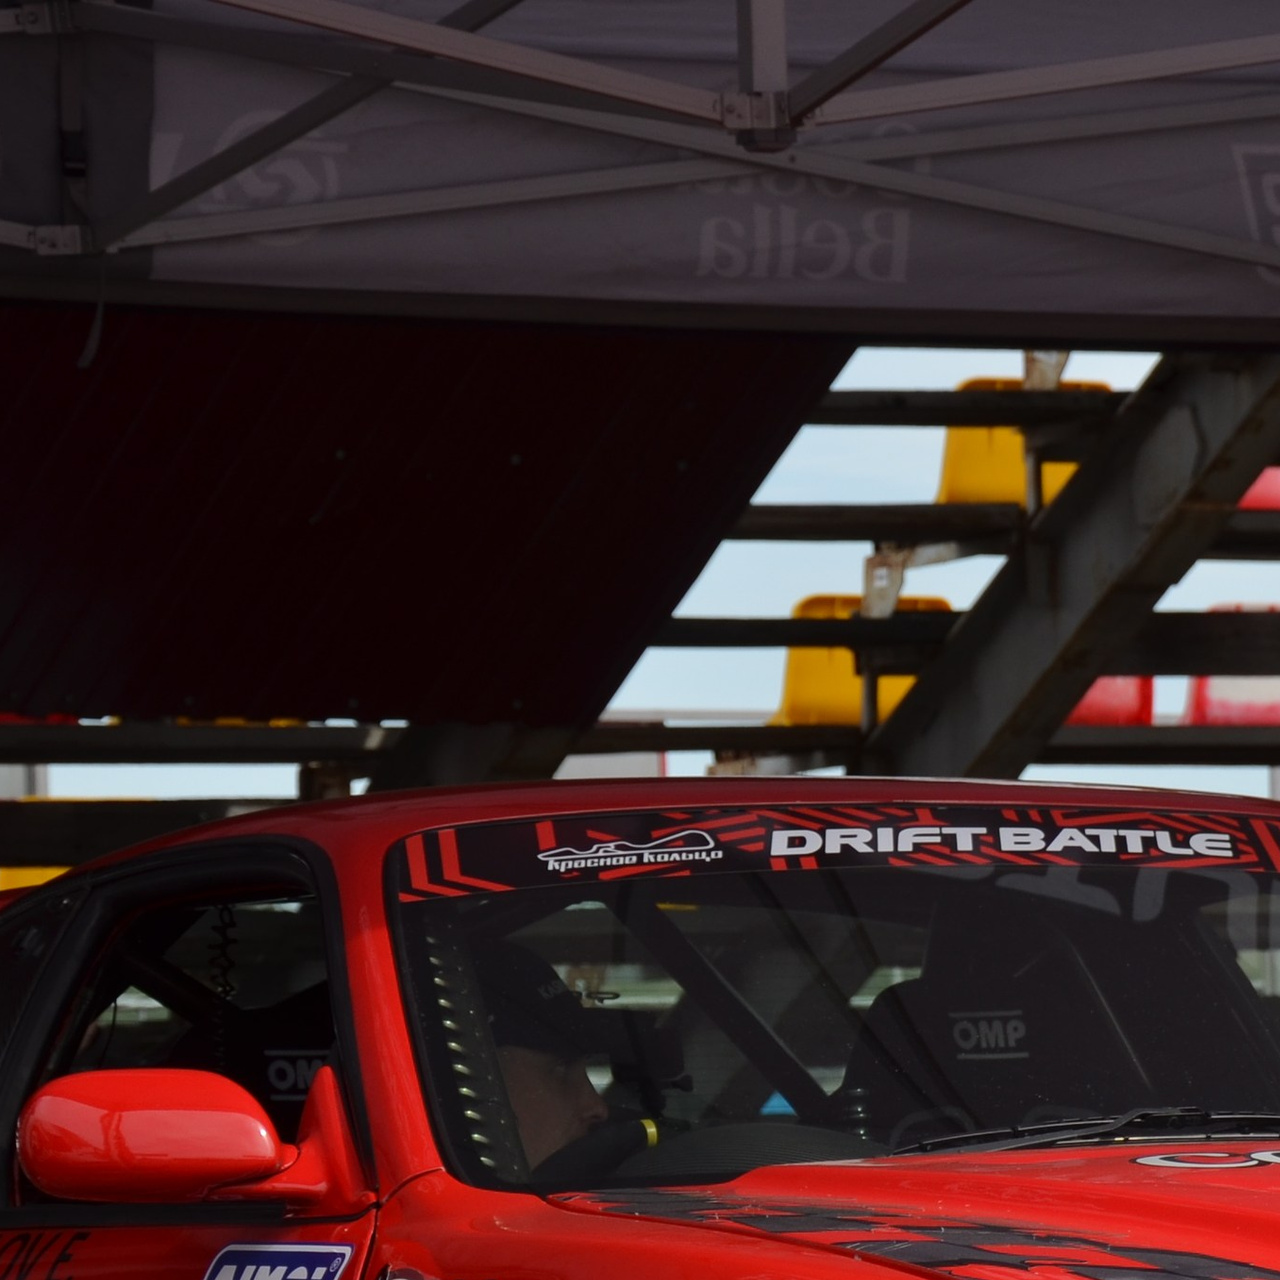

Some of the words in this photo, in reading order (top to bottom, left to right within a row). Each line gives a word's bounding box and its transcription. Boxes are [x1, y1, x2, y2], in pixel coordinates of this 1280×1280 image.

[770, 826, 988, 856] DRIFT
[999, 826, 1234, 857] BATTLE
[952, 1018, 1027, 1051] OMP
[267, 1058, 323, 1092] OM
